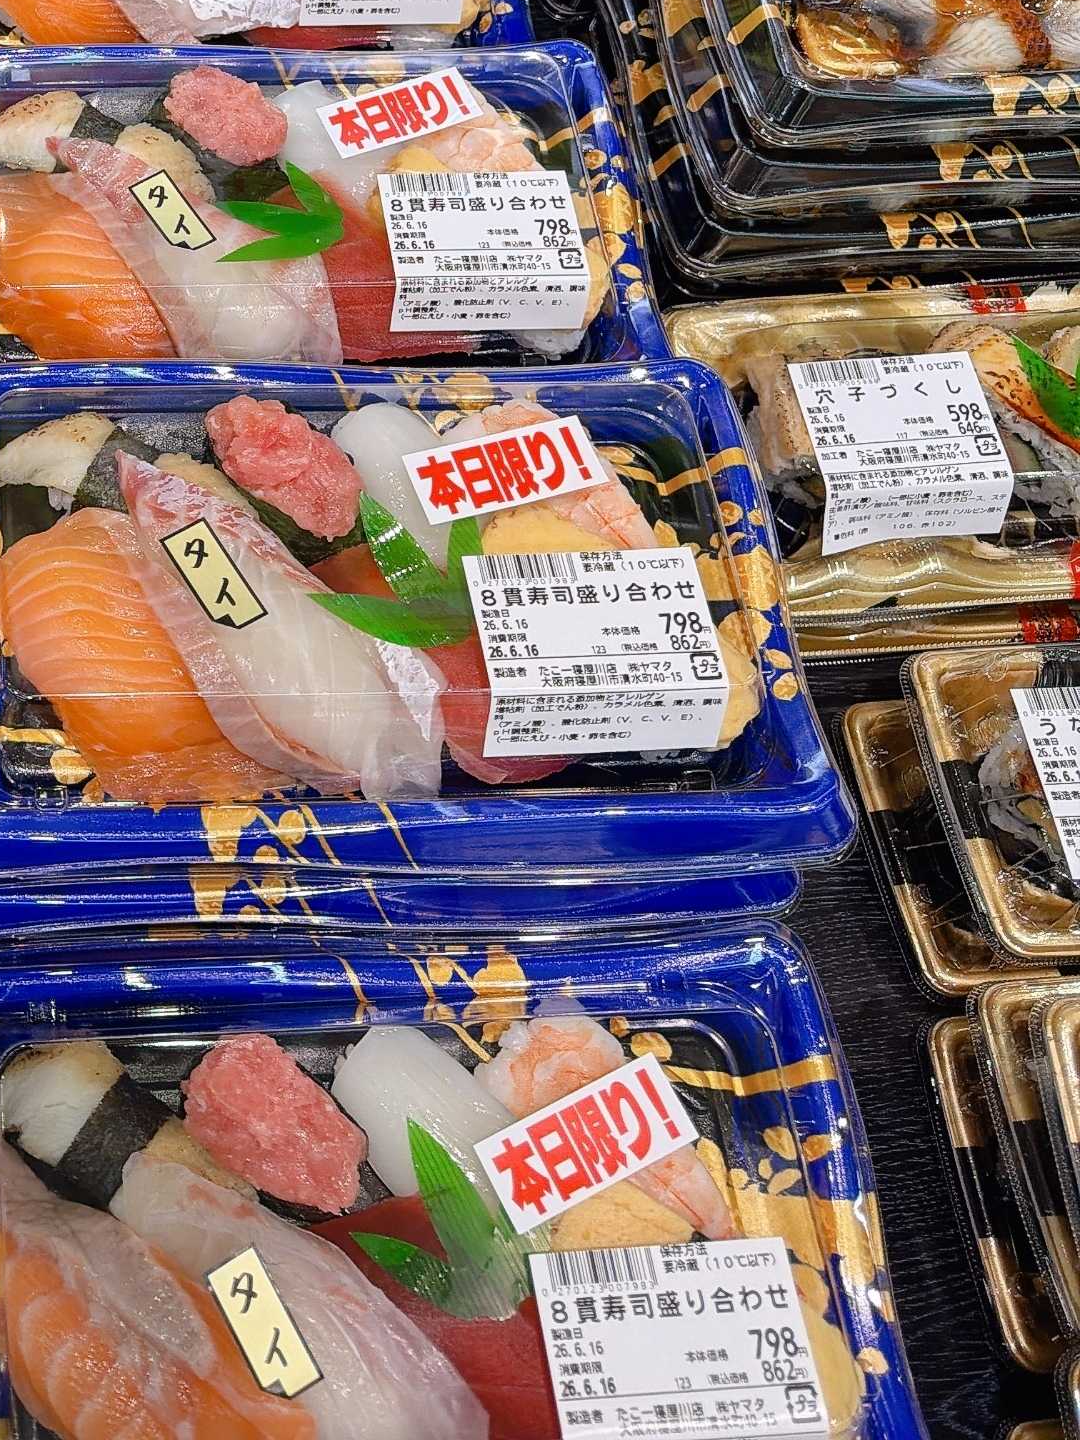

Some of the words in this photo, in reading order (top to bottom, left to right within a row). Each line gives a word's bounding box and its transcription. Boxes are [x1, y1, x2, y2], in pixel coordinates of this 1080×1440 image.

[330, 76, 470, 149] 本日限り!
[148, 185, 193, 236] タイ
[391, 196, 566, 212] 8貫寿司盛り合わせ
[395, 241, 435, 249] 26.6.16
[816, 379, 961, 404] 穴子づくし
[810, 415, 845, 424] 26.6.16
[903, 416, 934, 425] 本体価格
[816, 434, 855, 446] 26.6.16
[415, 424, 590, 513] 本日限り!
[183, 538, 236, 605] タイ
[481, 581, 696, 607] 8貫寿司盛り合わせ
[481, 609, 509, 618] 製造日
[484, 619, 528, 631] 26.6.16
[601, 627, 640, 636] 本体価格
[488, 634, 527, 643] 消費期限
[489, 645, 539, 658] 26.6.16
[592, 646, 606, 654] 123
[494, 667, 527, 678] 製造者
[1037, 746, 1077, 758] 26.6.16
[493, 1067, 679, 1213] 本日限り!
[551, 1283, 789, 1324] 8貫寿司盛り合わせ
[229, 1277, 284, 1367] タイ
[553, 1341, 604, 1359] 26.6.16
[685, 1350, 728, 1362] 本体価格
[559, 1361, 604, 1376] 消費期限
[560, 1377, 616, 1397] 26.6.16
